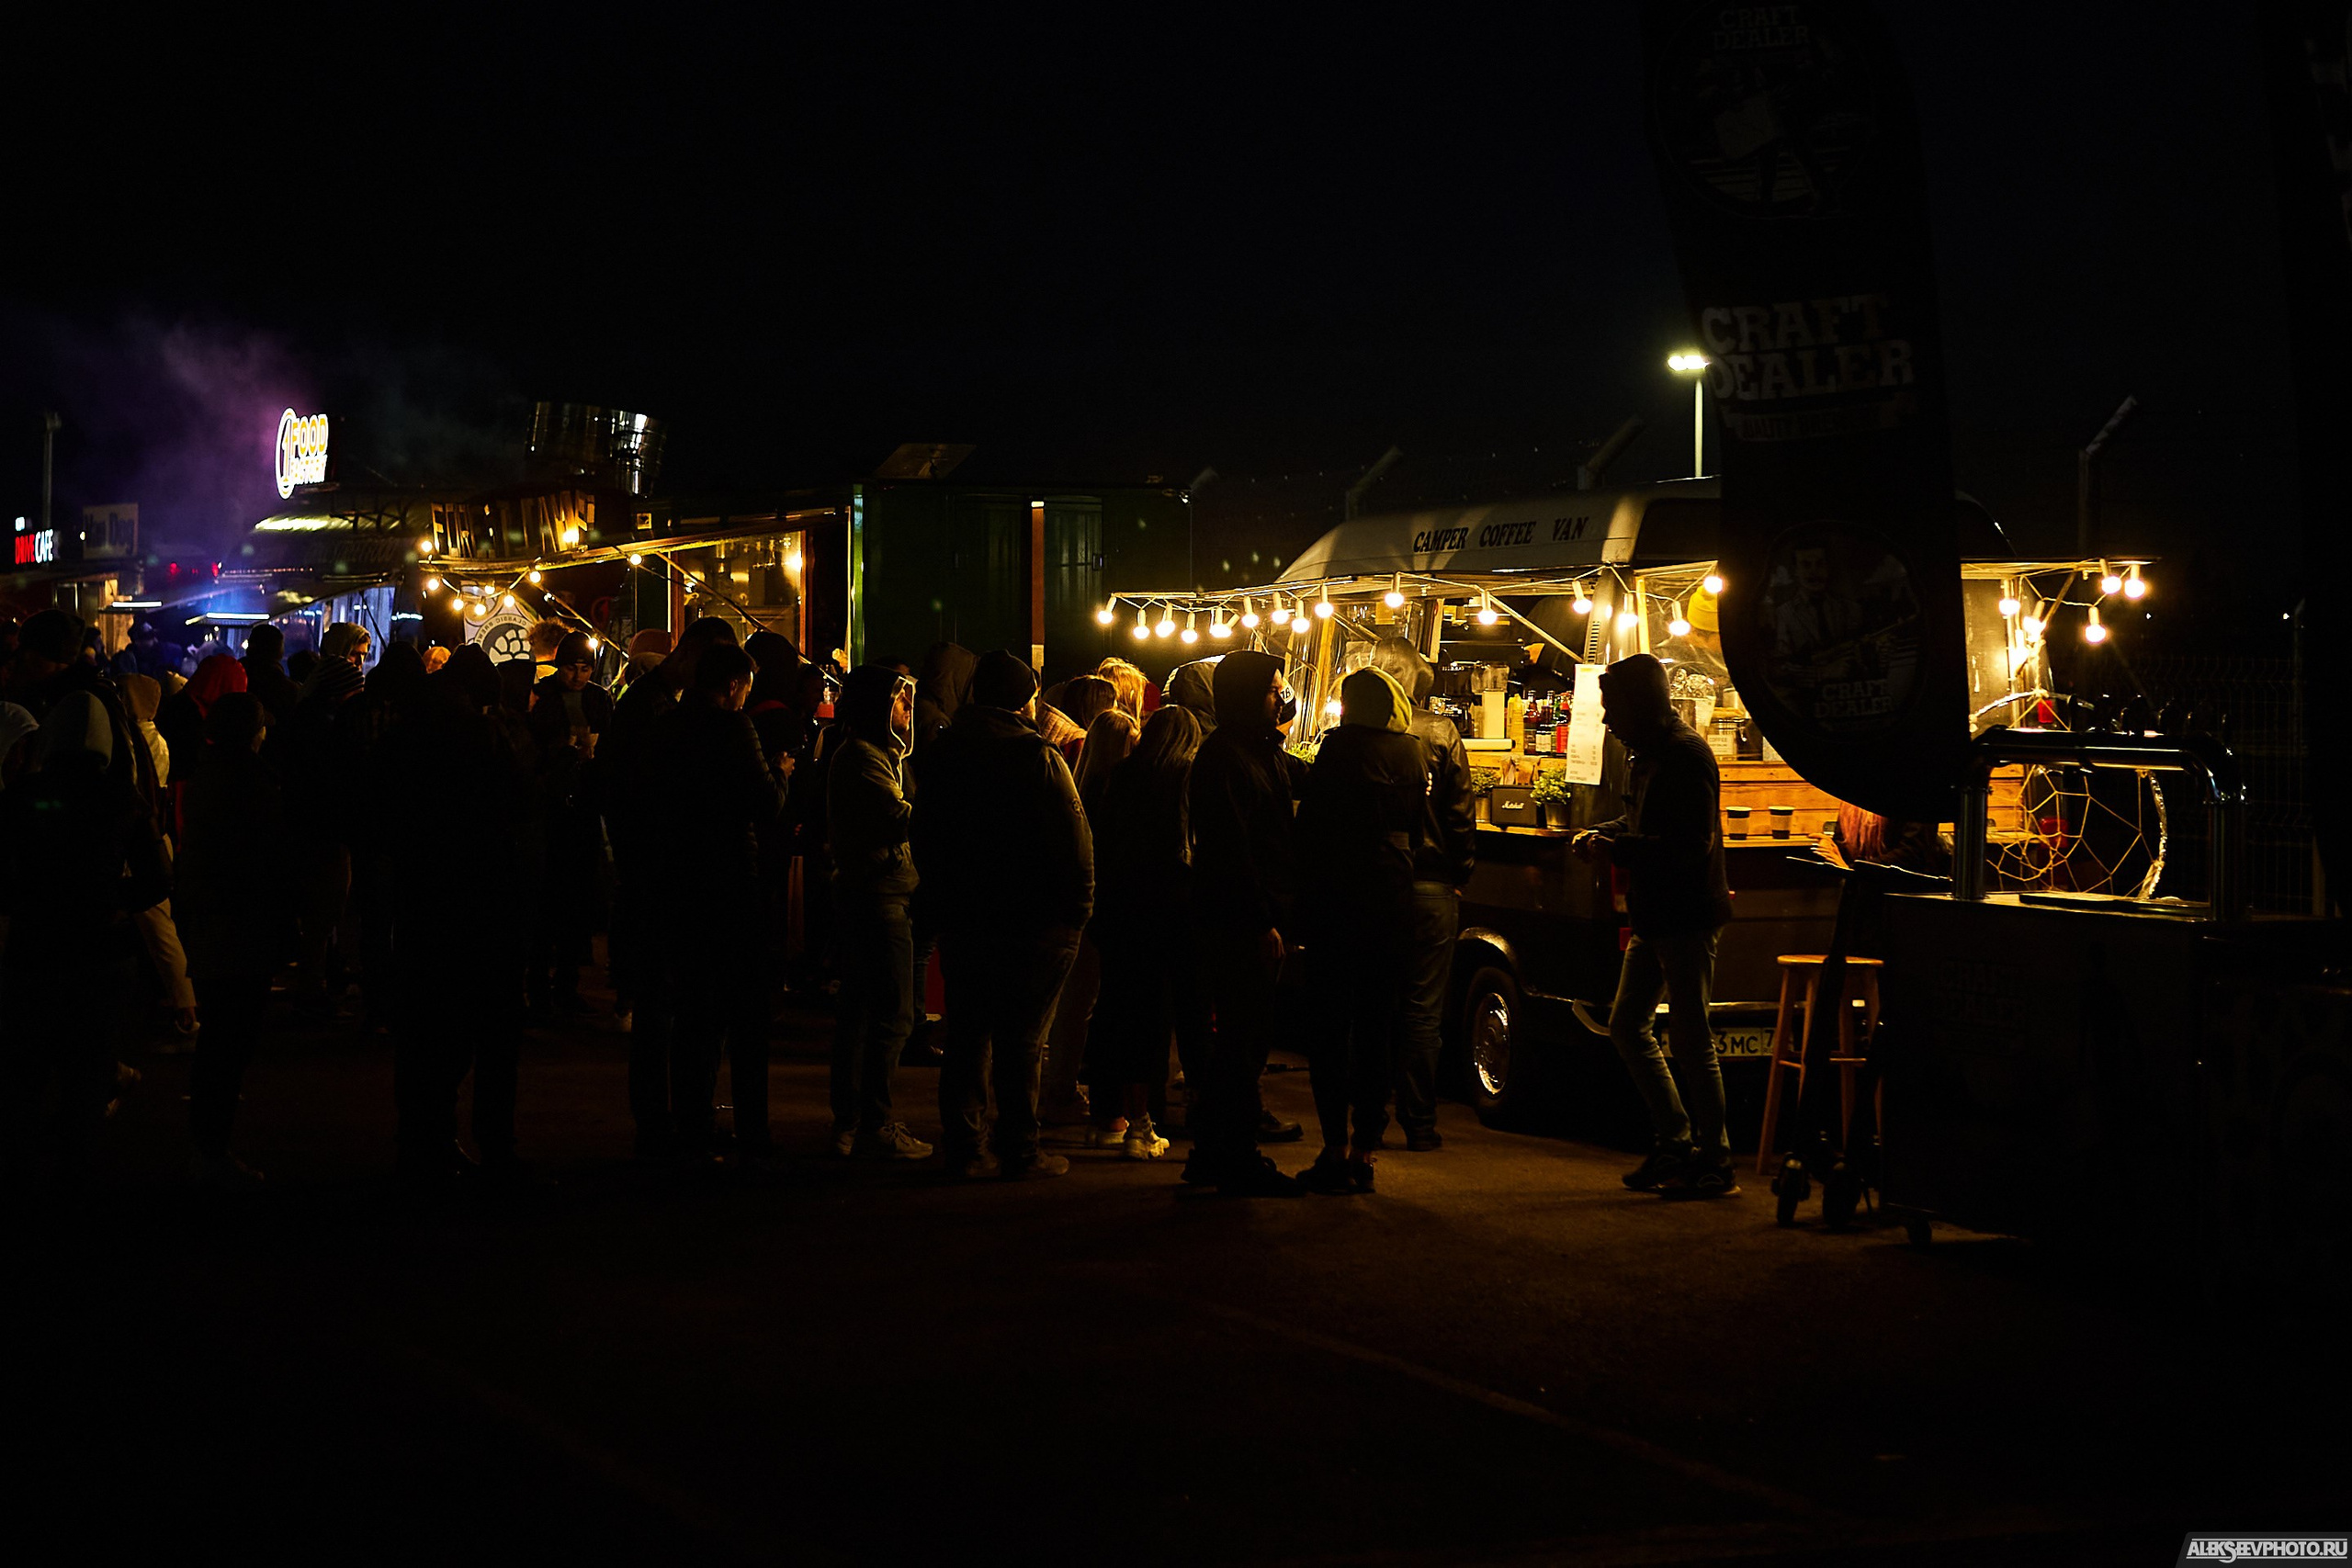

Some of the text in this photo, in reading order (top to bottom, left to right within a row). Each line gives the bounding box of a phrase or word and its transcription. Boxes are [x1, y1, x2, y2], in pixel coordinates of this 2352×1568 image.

[1718, 6, 1799, 29] CRAFT
[1713, 26, 1811, 51] DEALER
[1702, 293, 1889, 355] CRAFT
[1708, 339, 1915, 400] DEALER
[291, 413, 329, 457] FOOD
[16, 529, 54, 564] DRIVE CAFE
[1413, 516, 1589, 553] CAMPER COFFEE VAN
[1813, 695, 1894, 718] DEALER
[1821, 679, 1893, 701] CRAFT
